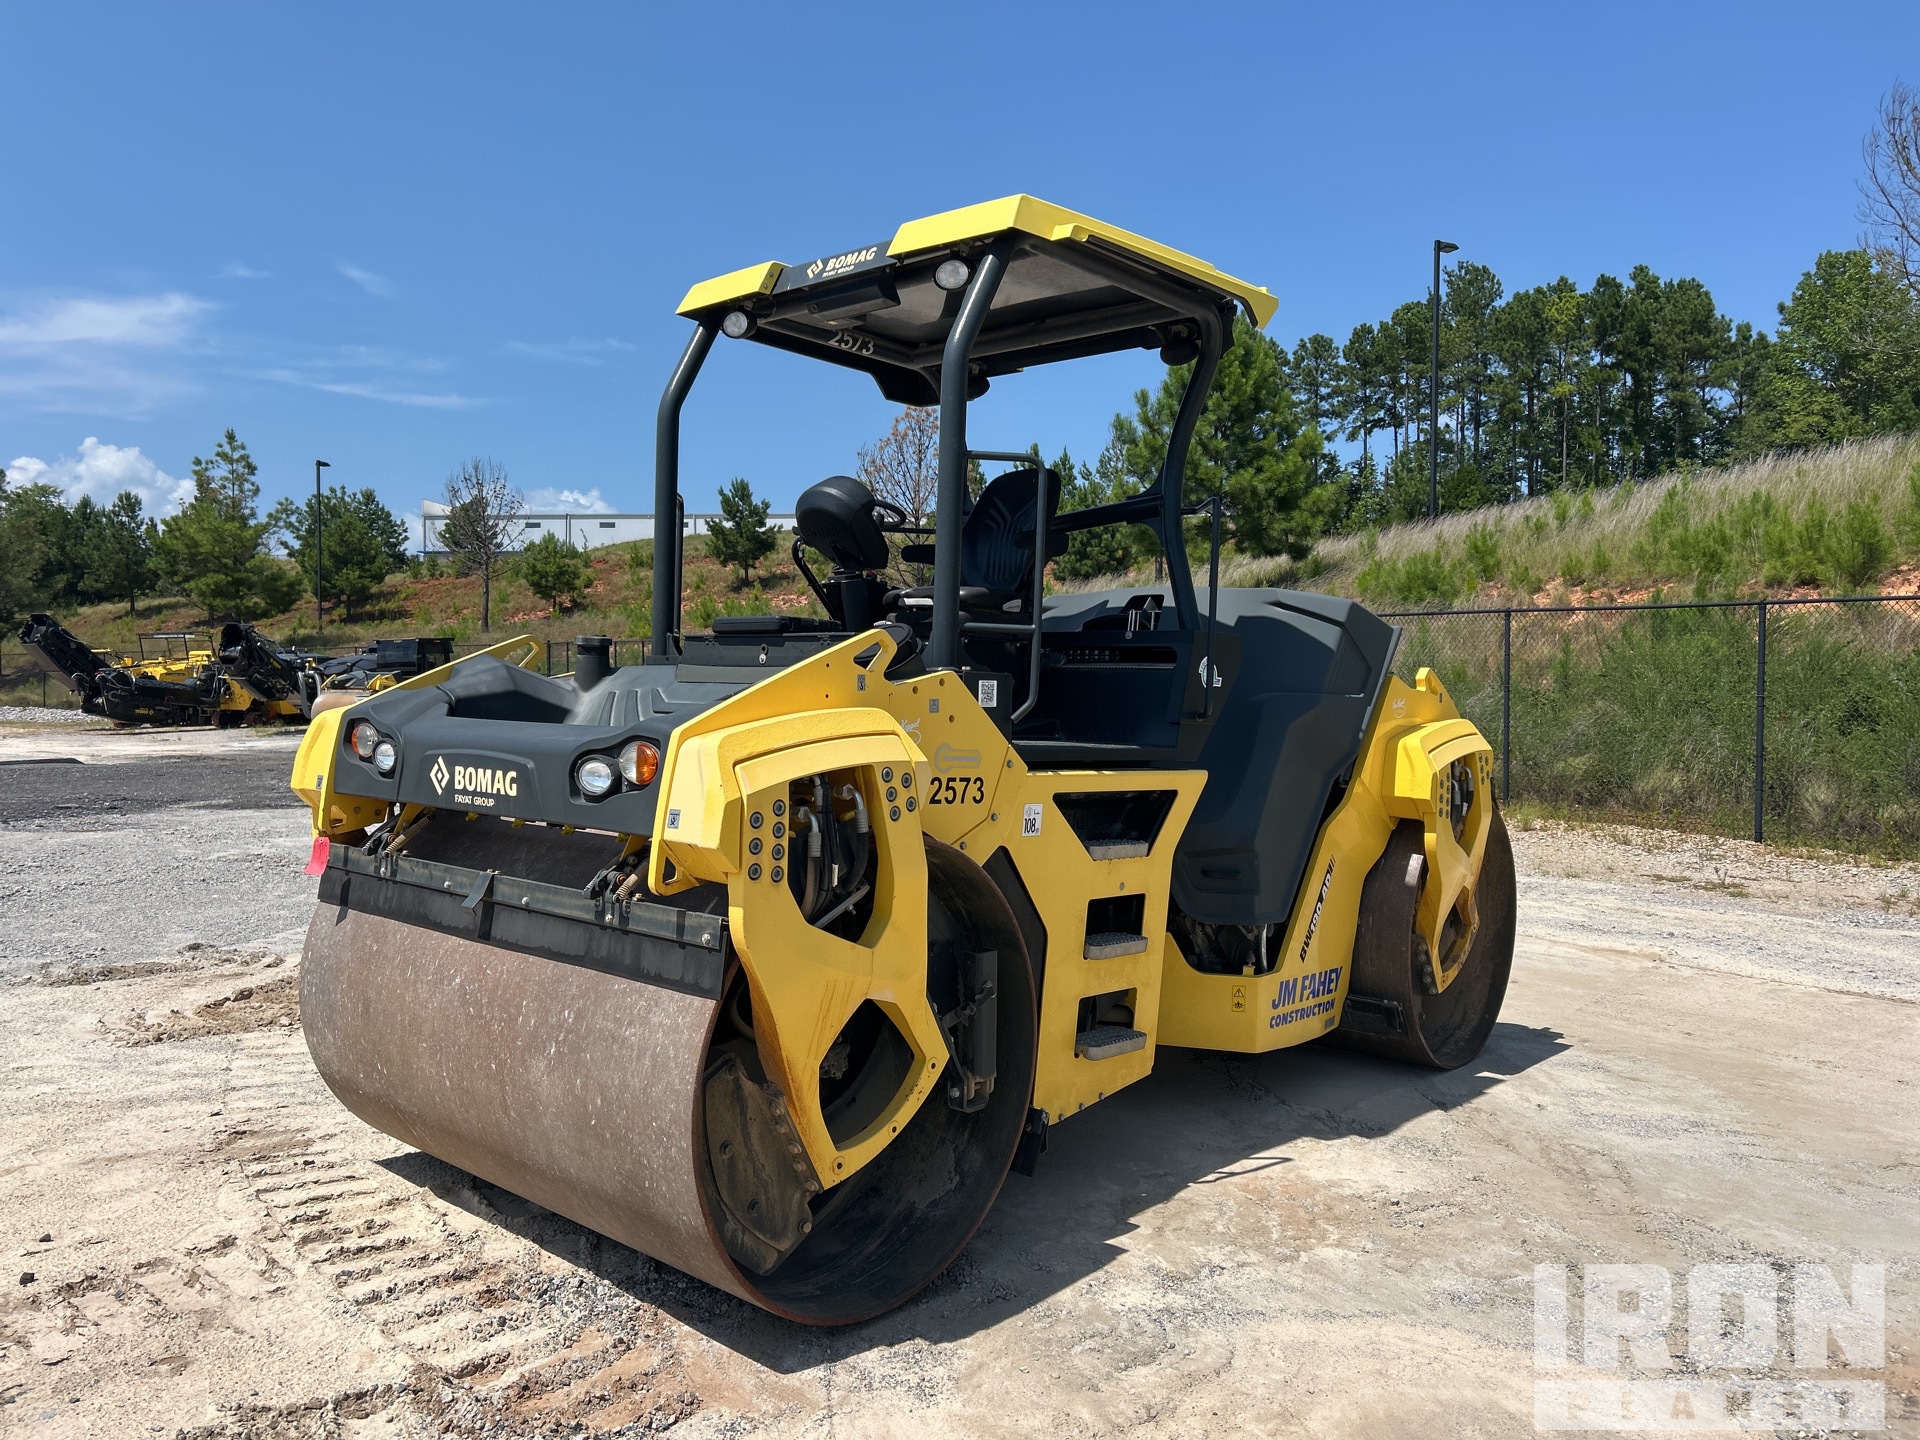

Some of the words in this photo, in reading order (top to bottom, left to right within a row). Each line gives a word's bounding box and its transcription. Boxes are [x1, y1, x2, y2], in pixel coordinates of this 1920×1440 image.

[825, 247, 877, 271] BOMAG
[454, 766, 517, 796] BOMAG
[929, 777, 985, 806] 2573
[454, 794, 472, 804] FAYAT
[473, 796, 495, 807] GROUP
[1024, 817, 1036, 834] 108
[1271, 977, 1298, 1010] JM
[1299, 966, 1343, 1002] FAHEY
[1269, 998, 1336, 1029] CONSTRUCTION
